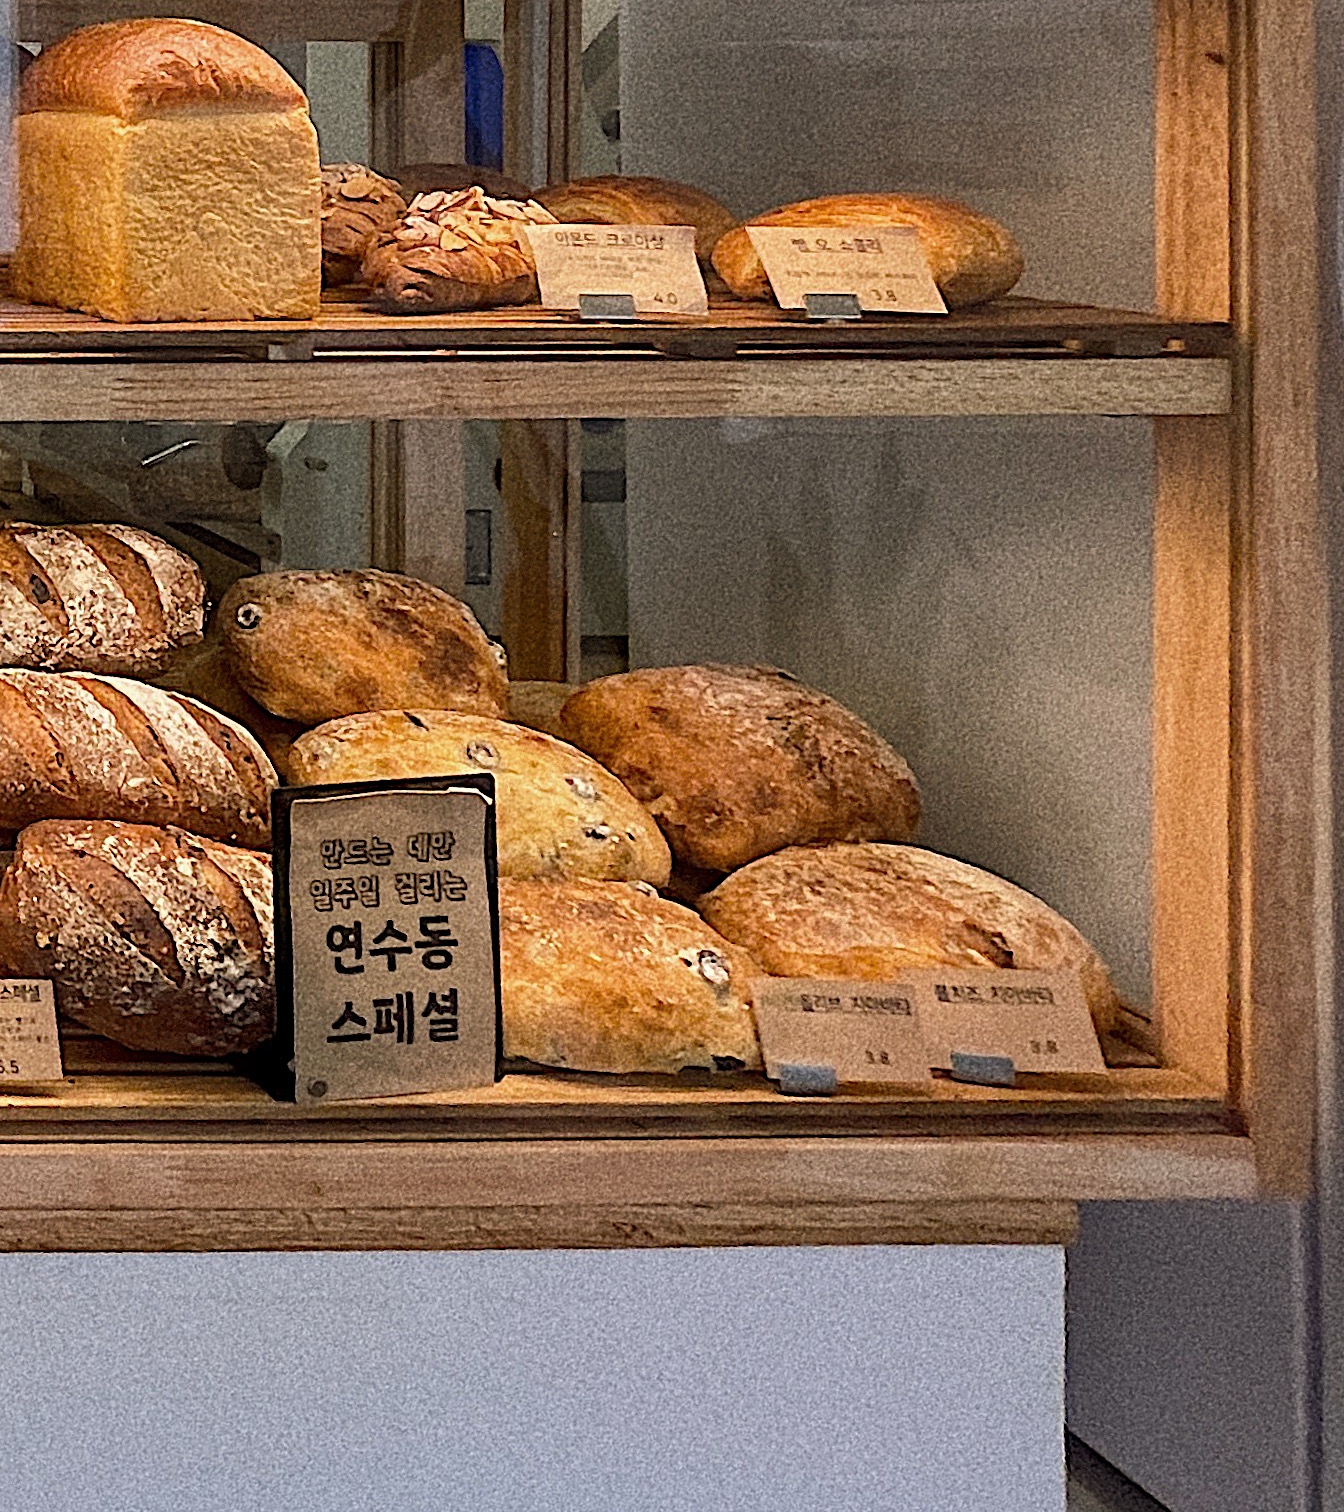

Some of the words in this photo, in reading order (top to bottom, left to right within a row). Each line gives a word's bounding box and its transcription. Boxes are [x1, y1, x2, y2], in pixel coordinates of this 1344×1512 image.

[320, 836, 394, 869] 만드는
[407, 830, 456, 862] 데만
[310, 875, 380, 912] 일주일
[395, 869, 468, 906] 걸리는
[326, 915, 459, 975] 연수동
[326, 988, 459, 1045] 스페셜
